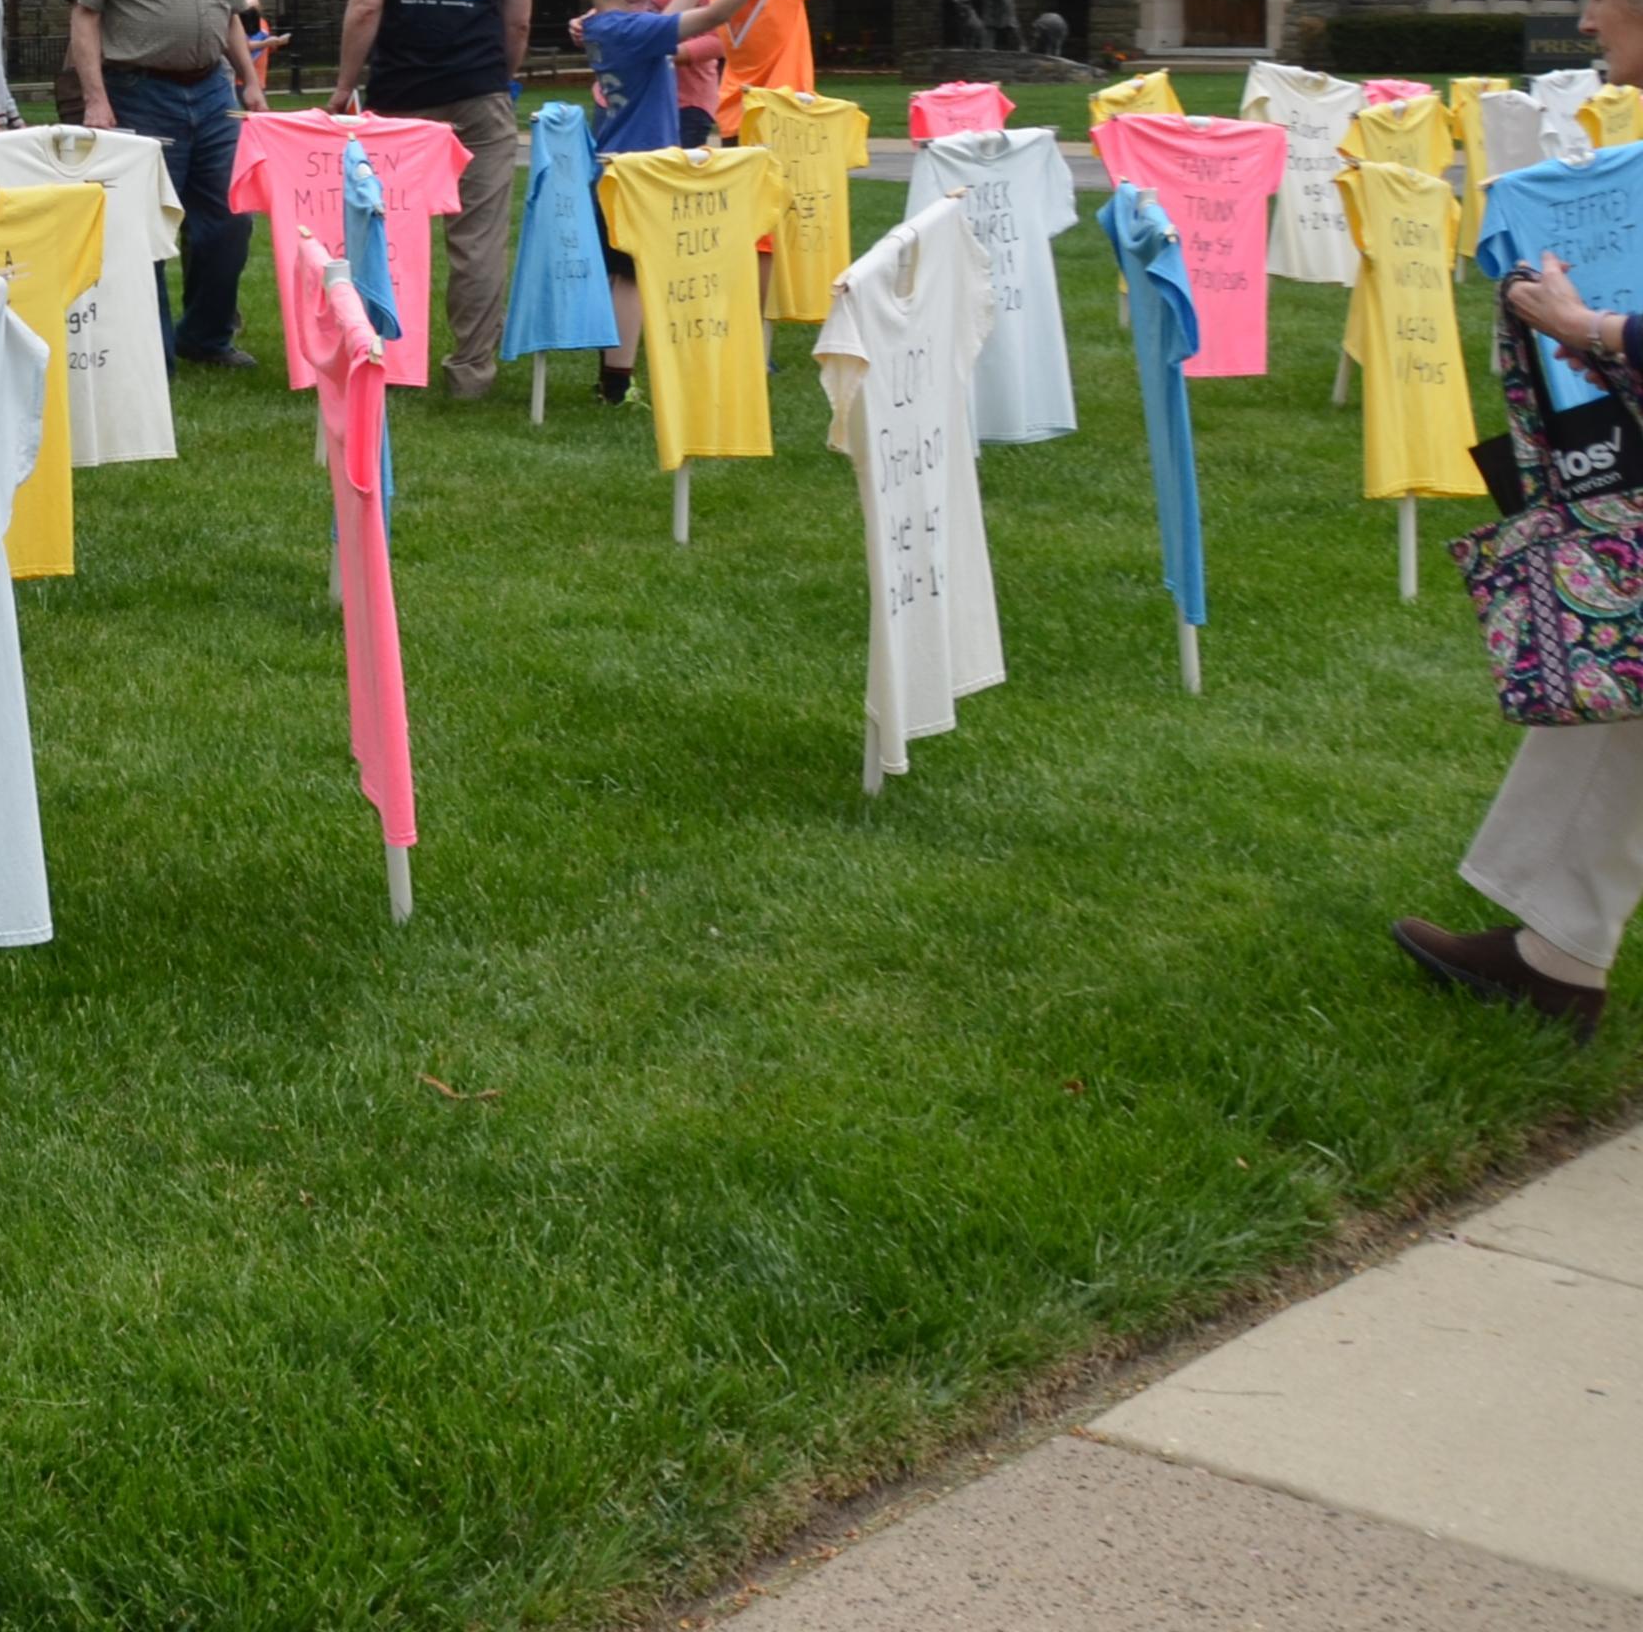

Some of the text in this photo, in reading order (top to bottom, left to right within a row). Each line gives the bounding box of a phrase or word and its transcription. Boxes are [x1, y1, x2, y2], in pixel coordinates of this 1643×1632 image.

[306, 152, 400, 177] STEN
[294, 187, 411, 218] MITLL
[672, 189, 729, 221] AARON
[676, 227, 720, 258] FLICK
[667, 277, 696, 304] AGE
[1572, 471, 1623, 495] verizon
